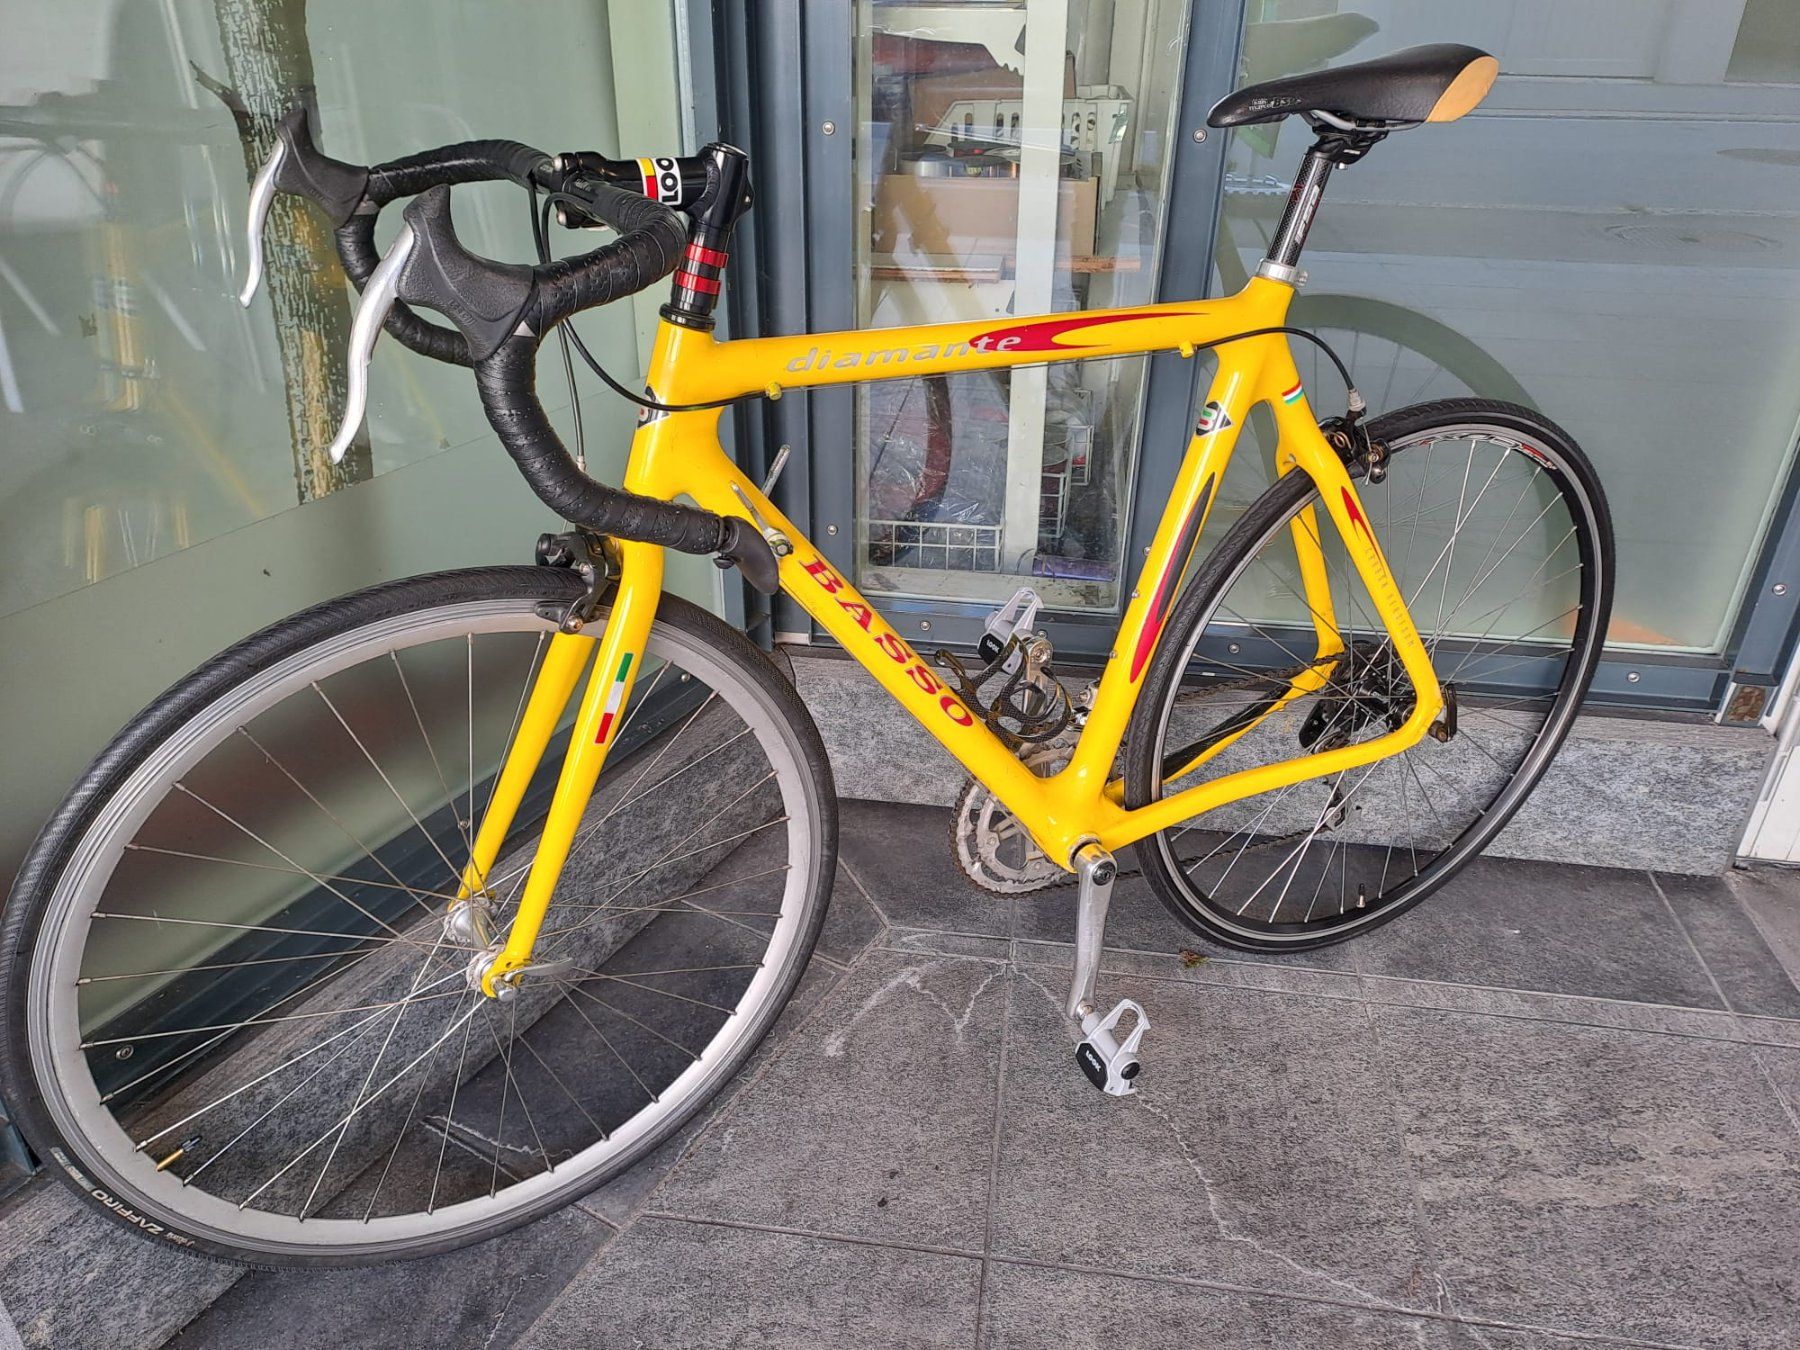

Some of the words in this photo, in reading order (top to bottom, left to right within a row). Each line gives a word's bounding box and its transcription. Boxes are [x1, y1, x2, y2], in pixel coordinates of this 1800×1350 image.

[786, 335, 1022, 373] diamante
[798, 553, 973, 727] BASSO
[91, 1189, 165, 1235] ZAFFIRO
